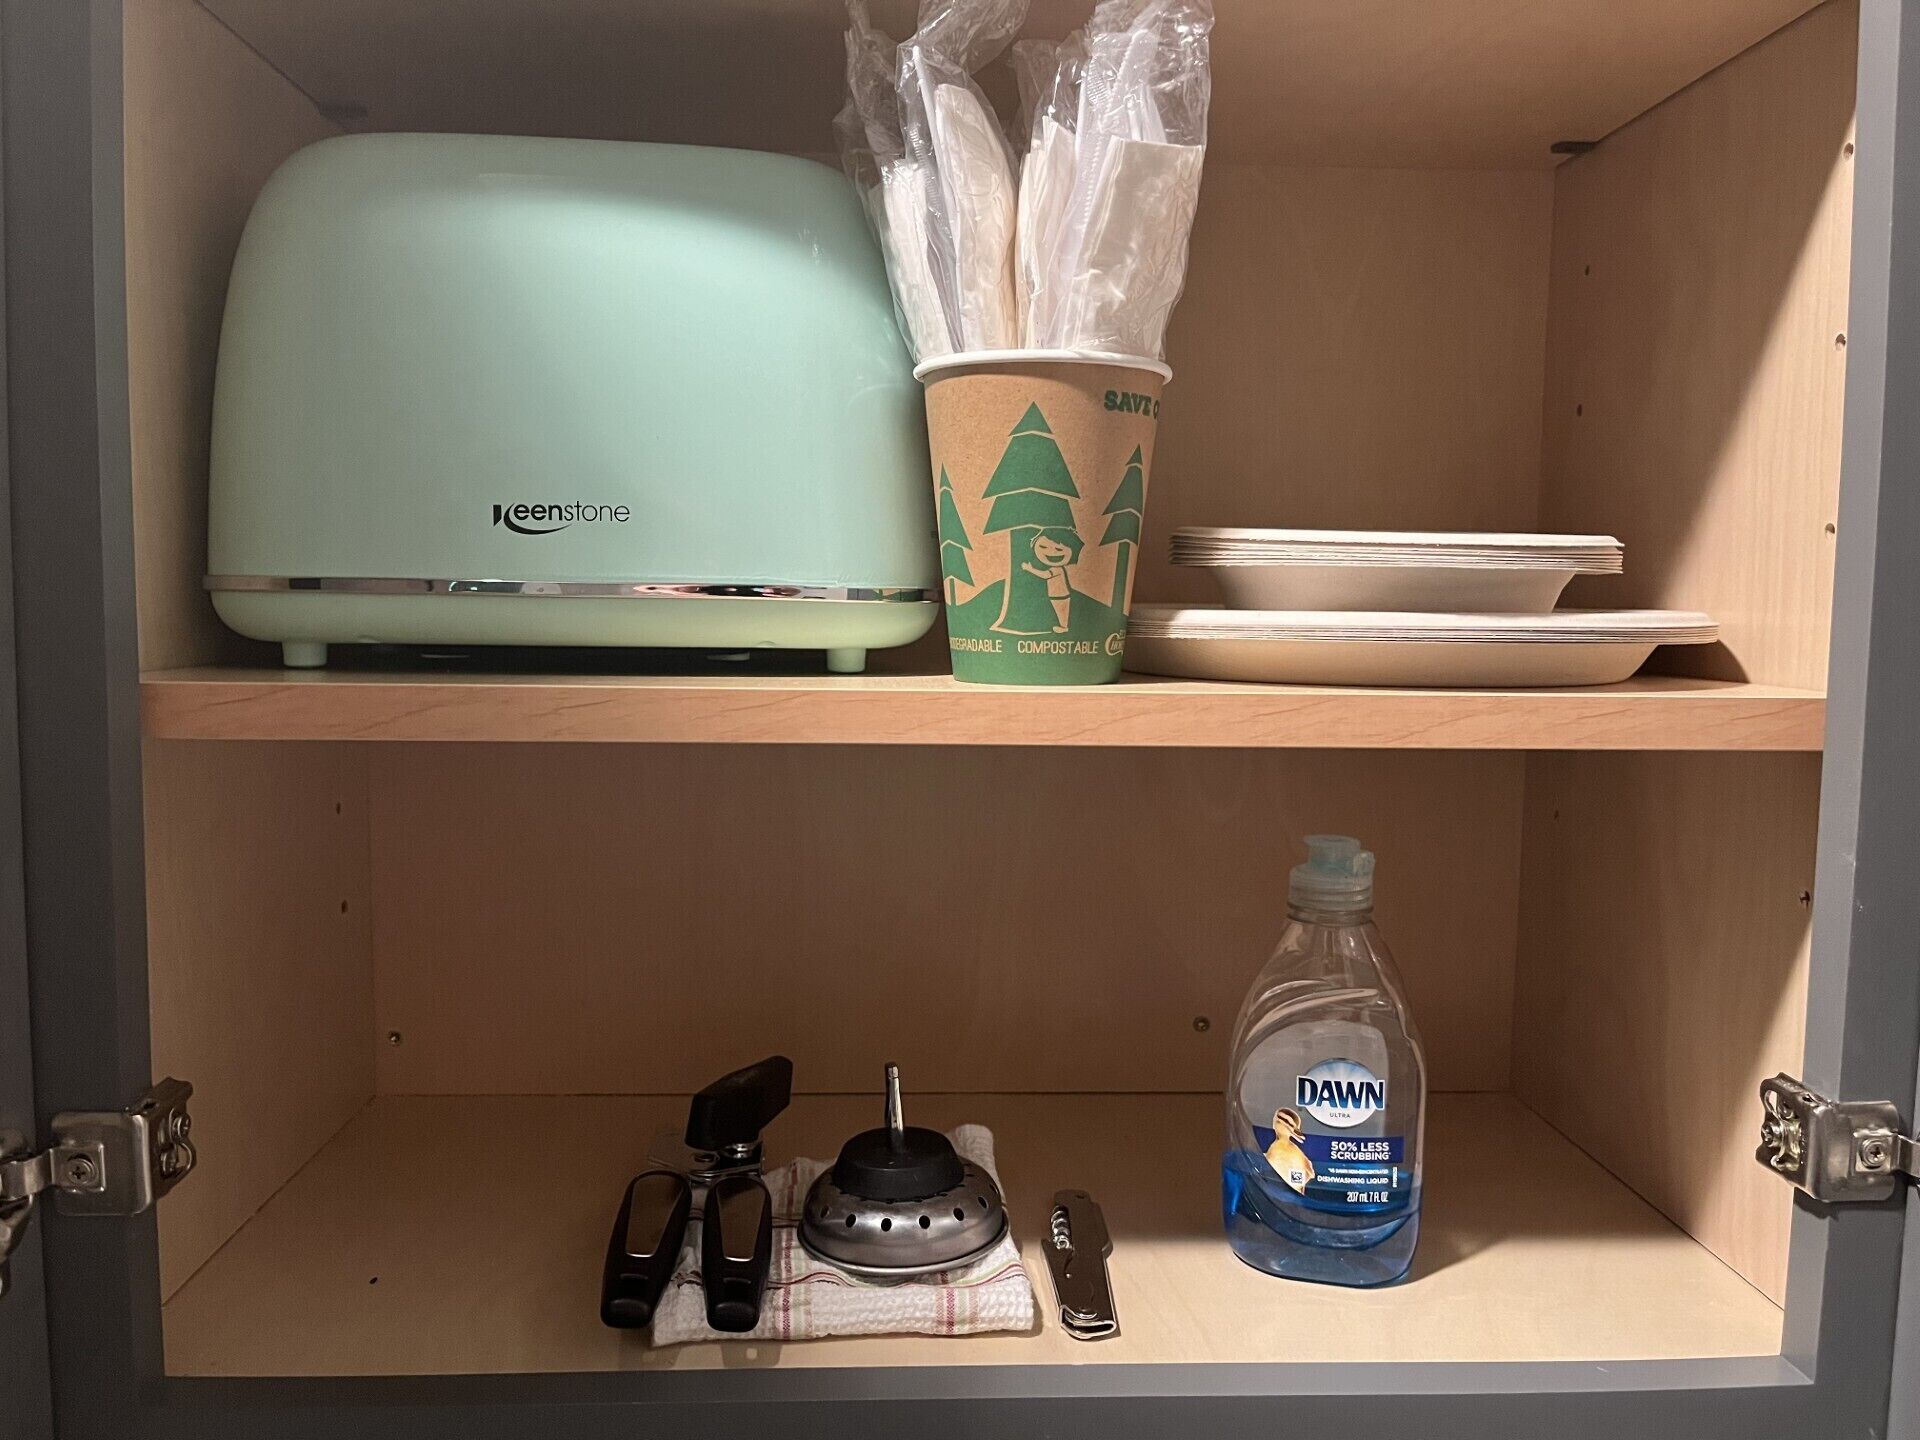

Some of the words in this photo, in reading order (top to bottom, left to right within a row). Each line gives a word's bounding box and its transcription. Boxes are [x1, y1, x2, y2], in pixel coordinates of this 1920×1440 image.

[1104, 390, 1151, 416] SAVE
[493, 501, 630, 535] Keenstone
[1017, 641, 1099, 654] COMPOSTABLE
[1297, 1077, 1385, 1110] DAWN
[1331, 1141, 1358, 1152] 50%
[1360, 1142, 1390, 1152] LESS
[1317, 1175, 1365, 1184] DISHWASHING
